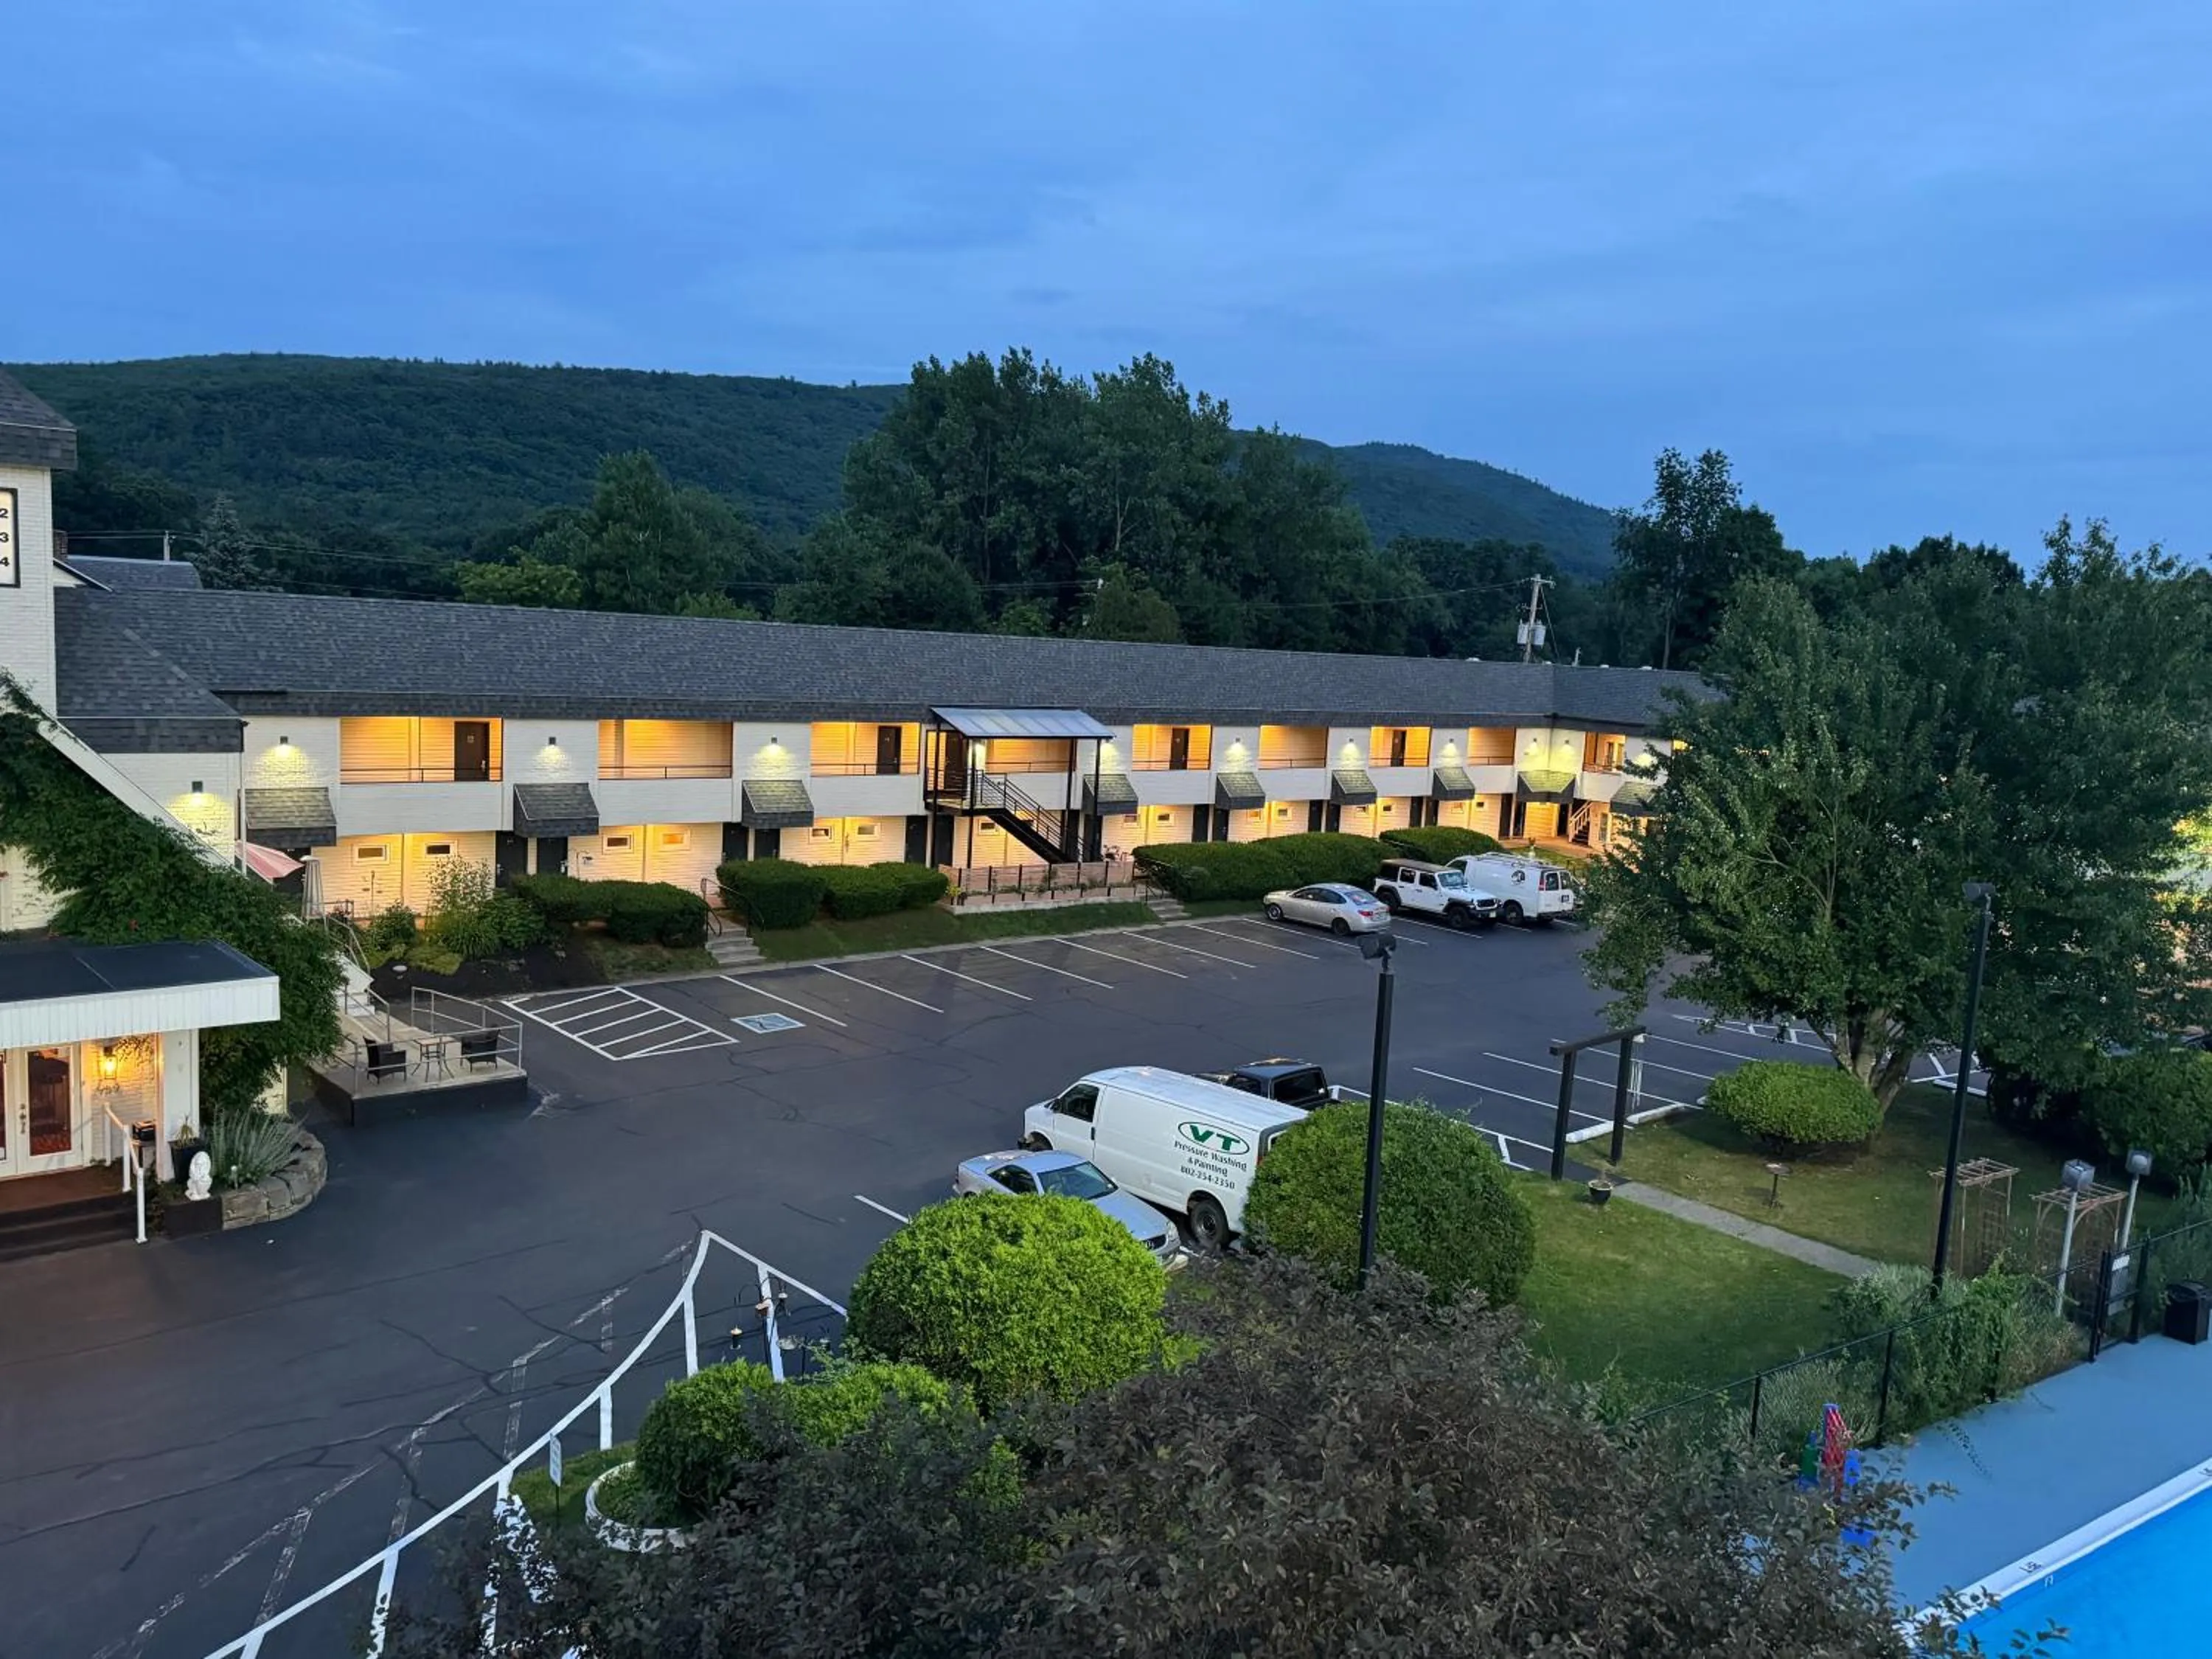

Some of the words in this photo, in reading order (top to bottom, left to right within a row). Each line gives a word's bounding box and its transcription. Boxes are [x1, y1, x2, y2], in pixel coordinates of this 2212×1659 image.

[1189, 1124, 1240, 1151] VT
[1174, 1141, 1209, 1158] Pressure
[1211, 1152, 1247, 1172] Washing
[1194, 1158, 1228, 1178] Painting
